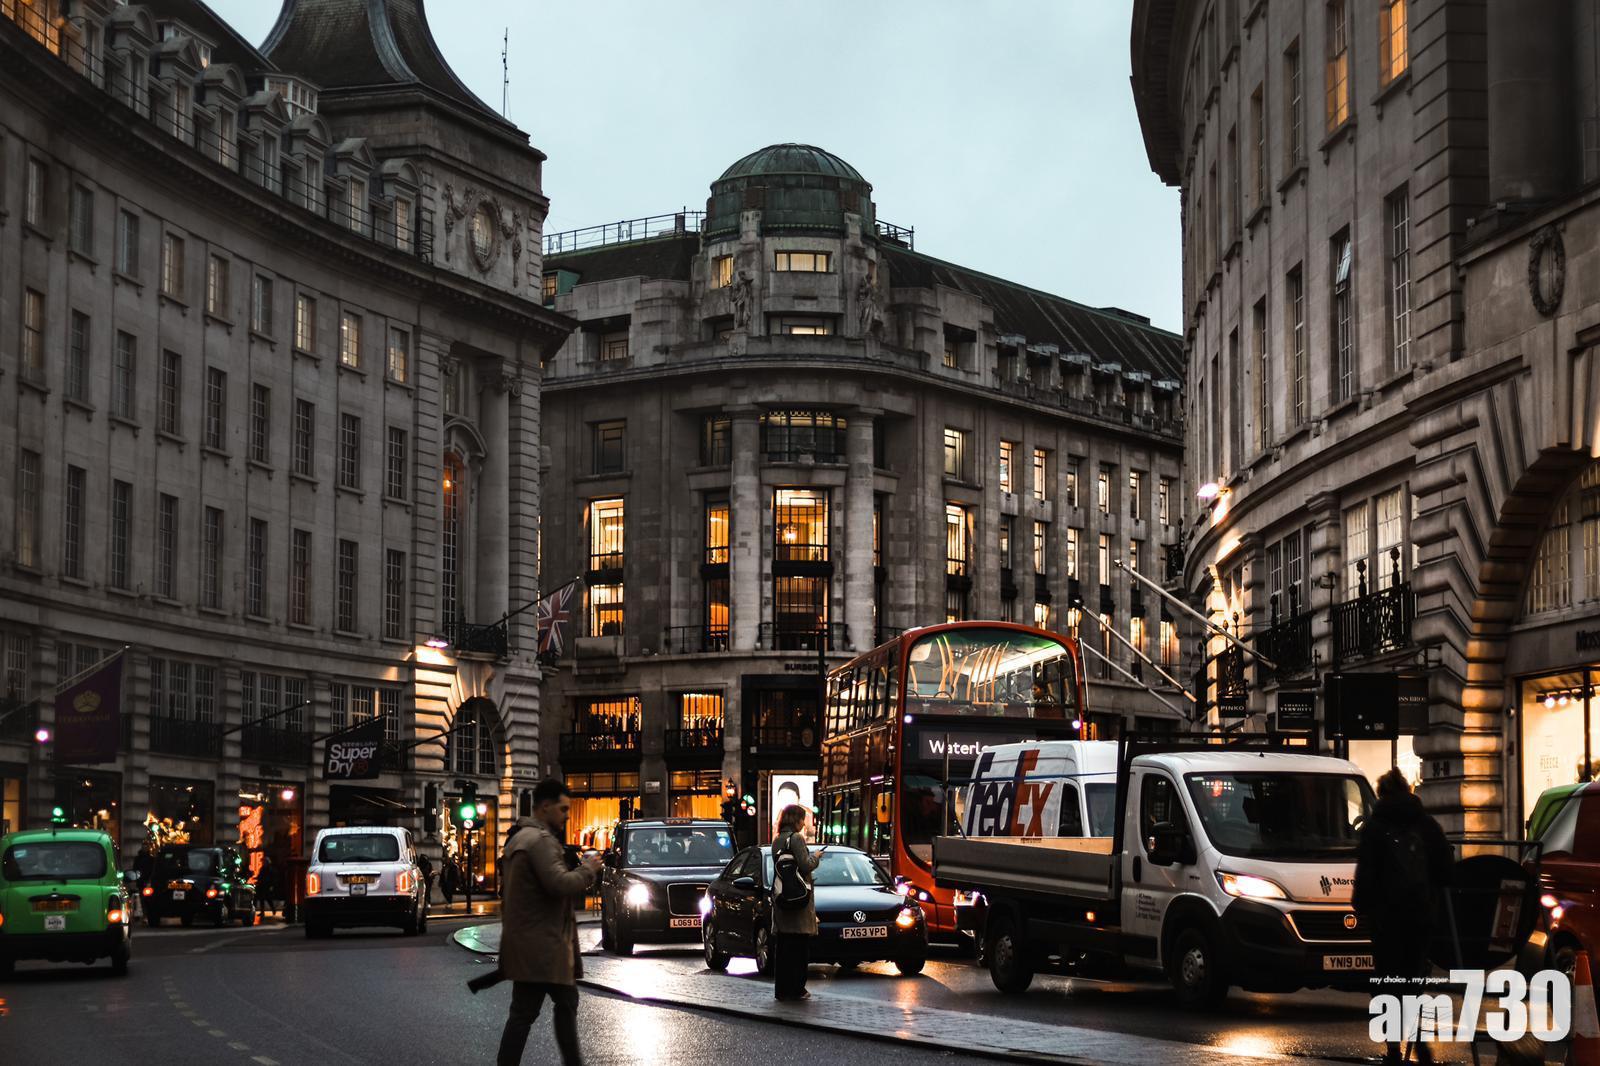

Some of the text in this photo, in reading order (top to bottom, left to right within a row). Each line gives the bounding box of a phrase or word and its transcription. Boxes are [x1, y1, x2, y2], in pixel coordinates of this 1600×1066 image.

[785, 663, 829, 671] BURBERY
[330, 743, 377, 763] Super
[929, 740, 989, 755] Waterl
[328, 760, 354, 777] Dry
[967, 749, 1054, 836] FedEx
[844, 927, 886, 938] FX63 VPC
[1330, 957, 1353, 968] YN19
